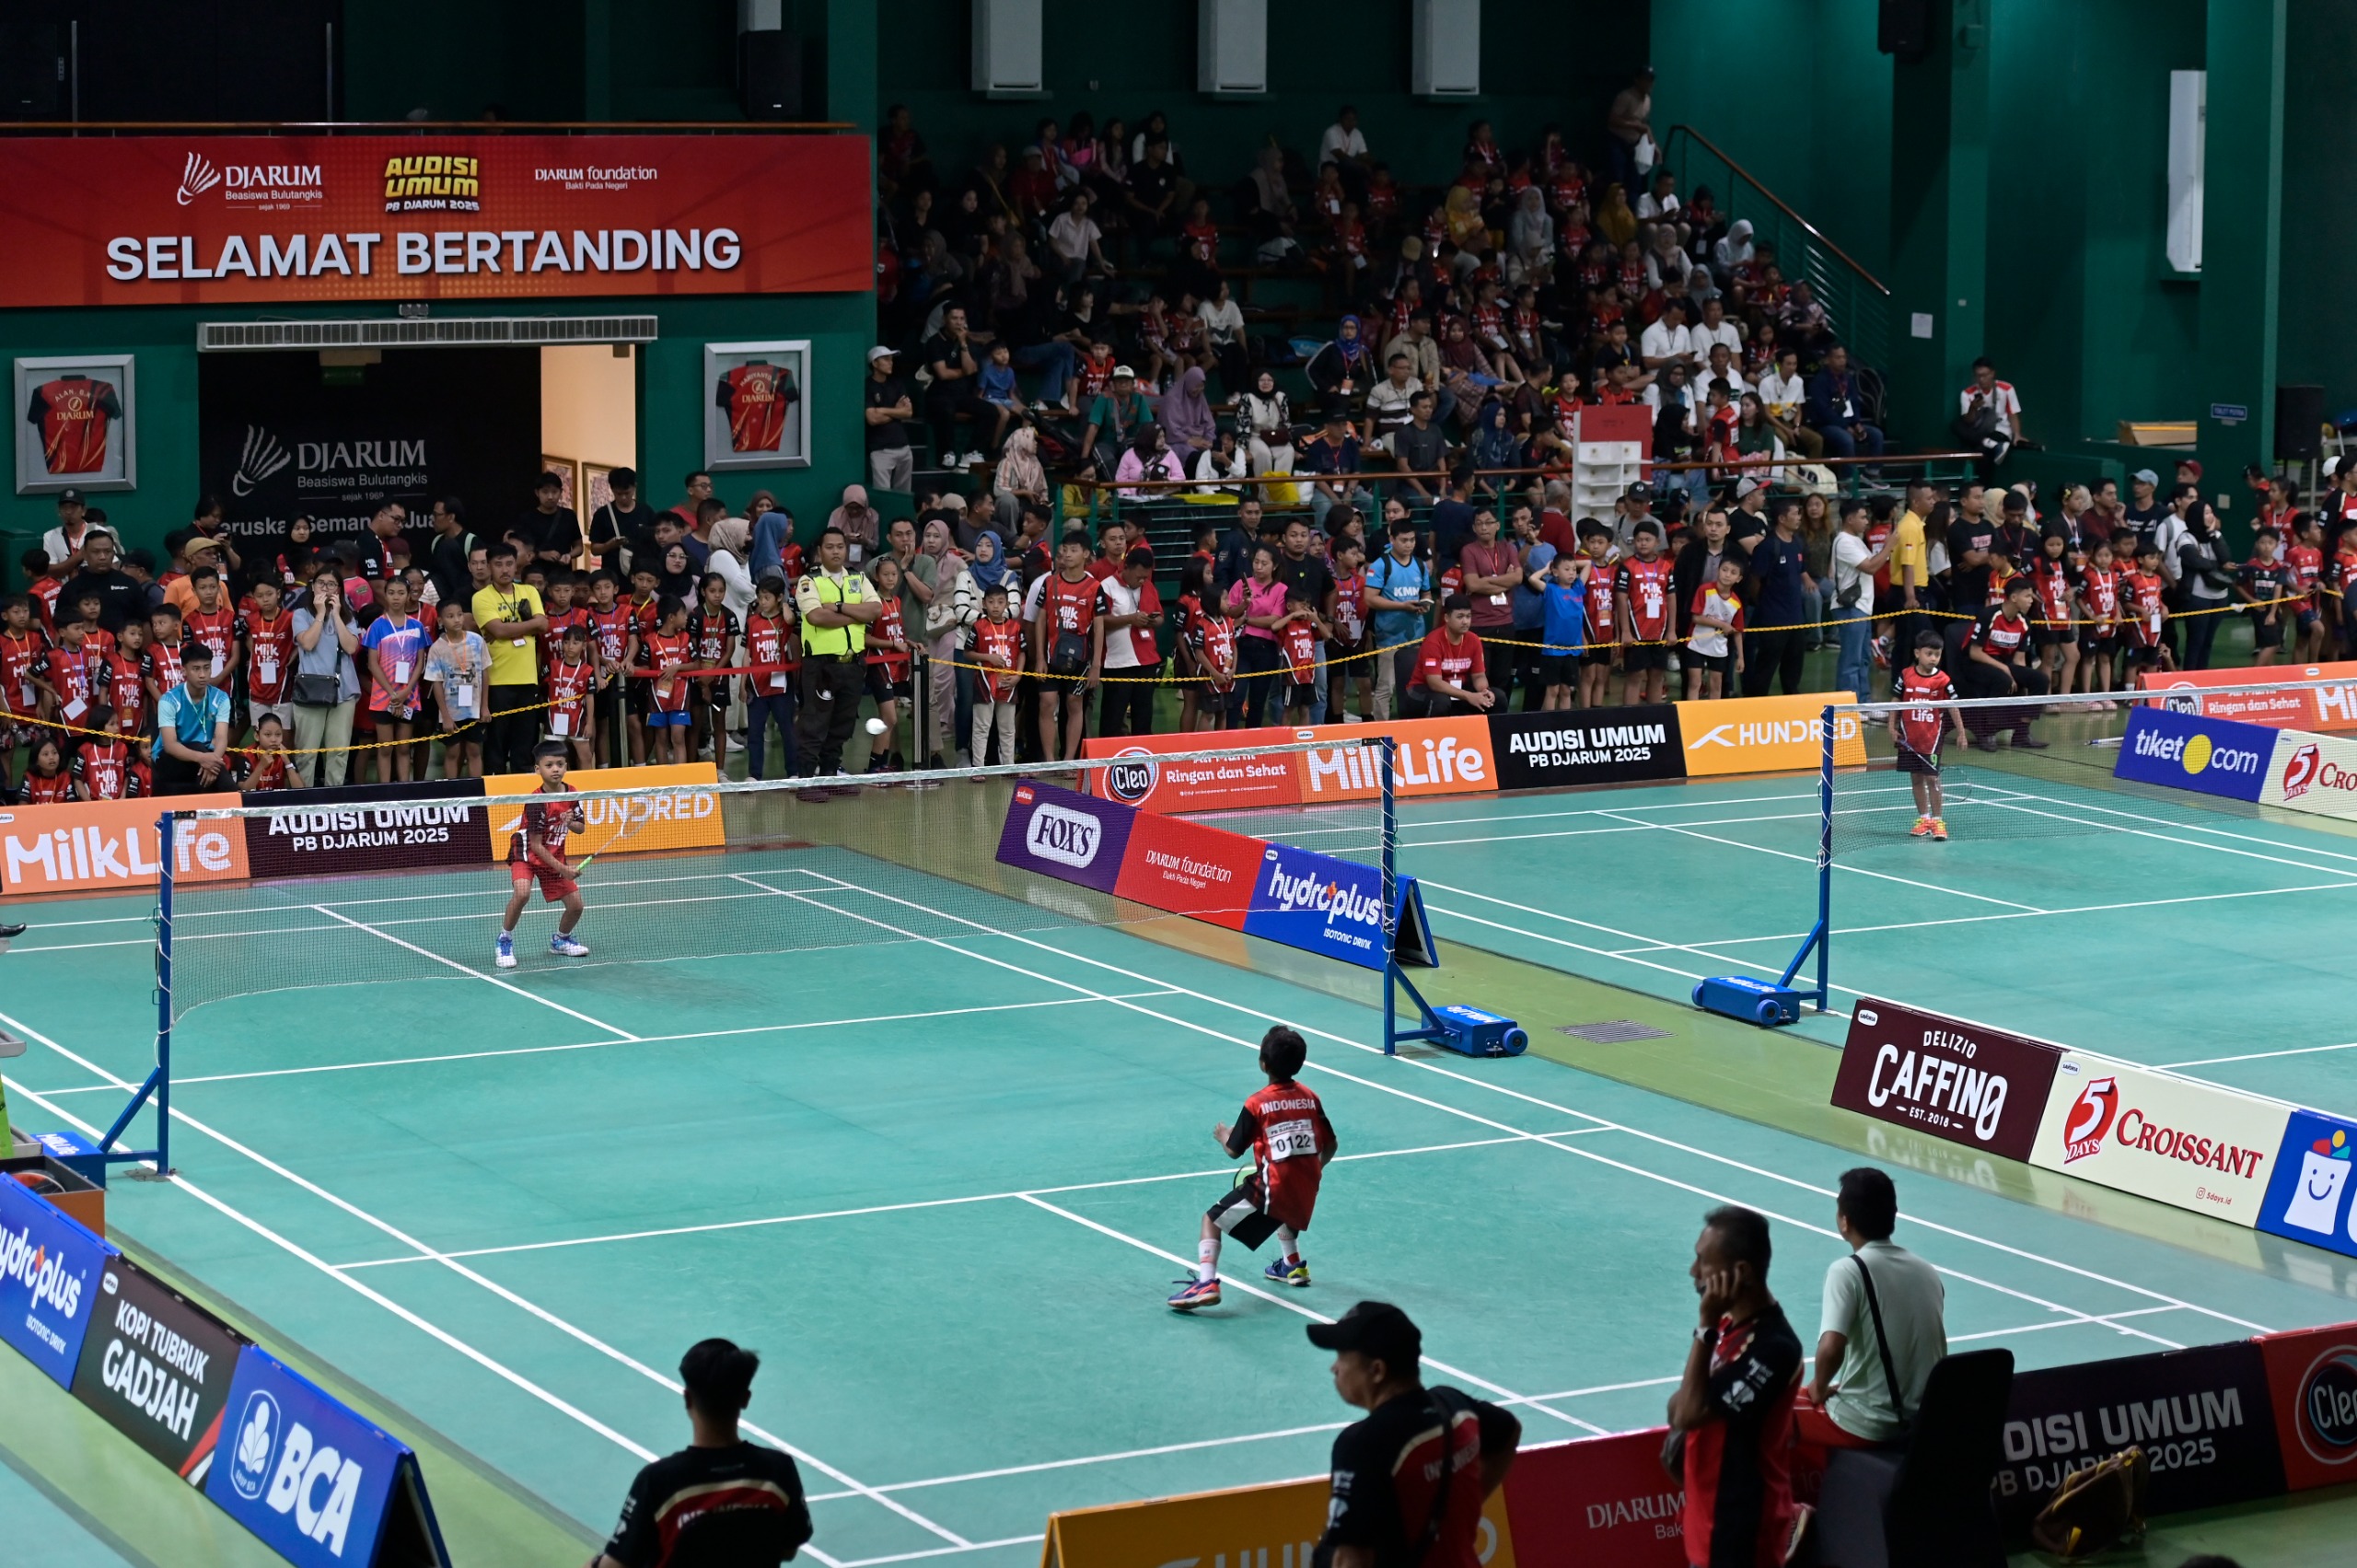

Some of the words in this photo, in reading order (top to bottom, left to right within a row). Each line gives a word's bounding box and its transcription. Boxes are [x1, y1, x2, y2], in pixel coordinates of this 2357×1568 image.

[226, 165, 322, 189] DJARUM
[385, 156, 478, 177] AUDISI
[535, 168, 584, 181] DJARUM
[587, 166, 657, 180] foundation
[226, 191, 269, 201] Beasiswa
[271, 190, 322, 202] Bulutangkis
[385, 177, 479, 198] UMUM
[605, 182, 628, 191] Negeri
[385, 201, 401, 212] PB
[403, 200, 447, 211] DJARUM
[449, 200, 480, 212] 2025
[106, 233, 380, 281] SELAMAT
[397, 227, 740, 274] BERTANDING
[297, 440, 427, 473] DJARUM
[297, 475, 355, 488] Beasiswa
[359, 473, 428, 487] Bulutangkis
[342, 494, 363, 503] sejak
[220, 517, 286, 537] eruska
[308, 514, 371, 534] Seman
[1640, 583, 1662, 595] Milk
[255, 644, 279, 656] Milk
[601, 645, 621, 657] Life
[701, 649, 721, 659] Life
[1295, 639, 1313, 649] Milk
[1297, 648, 1313, 659] Life
[119, 684, 139, 697] Milk
[122, 695, 140, 708] Life
[1911, 708, 1934, 723] Life
[2209, 702, 2246, 715] Ringan
[2247, 700, 2268, 712] dan
[2269, 697, 2301, 710] Sehat
[1510, 729, 1585, 754] AUDISI
[1591, 724, 1666, 748] UMUM
[1528, 754, 1549, 768] PB
[1550, 750, 1612, 767] DJARUM
[1614, 747, 1652, 762] 2025
[1114, 765, 1148, 791] Cleo
[1167, 769, 1215, 784] Ringan
[1217, 766, 1244, 780] dan
[1246, 763, 1287, 778] Sehat
[269, 811, 366, 835] AUDISI
[374, 807, 470, 828] UMUM
[579, 794, 714, 826] UNDRED
[293, 836, 318, 852] PB
[323, 830, 399, 850] DJARUM
[403, 828, 449, 843] 2025
[1034, 814, 1094, 857] FOX'S
[1145, 850, 1180, 870] DJARUM
[1182, 856, 1232, 883] foundation
[1268, 863, 1381, 925] hydroplus
[1323, 928, 1352, 945] ISOTONIC
[1353, 936, 1372, 950] DRINK
[1923, 1031, 1977, 1059] DELIZIO
[1867, 1043, 2007, 1141] CAFFINO
[1261, 1098, 1317, 1115] INDONESIA
[2069, 1080, 2111, 1144] 5
[1276, 1134, 1311, 1152] 0122
[2066, 1139, 2100, 1162] DAYS
[2117, 1109, 2263, 1179] CROISSANT
[2206, 1192, 2232, 1205] 5days.id
[0, 1220, 81, 1319] ydroplus
[26, 1314, 50, 1342] ISOTONIC
[50, 1332, 66, 1355] DRINK
[115, 1299, 152, 1345] KOPI
[149, 1320, 210, 1384] TUBRUK
[102, 1339, 199, 1441] GADJAH
[2003, 1411, 2088, 1462] DISI
[2099, 1388, 2243, 1446] UMUM
[2149, 1437, 2216, 1472] 2025
[266, 1422, 363, 1558] BCA
[1587, 1492, 1686, 1529] DJARUM
[1655, 1522, 1685, 1540] Bak
